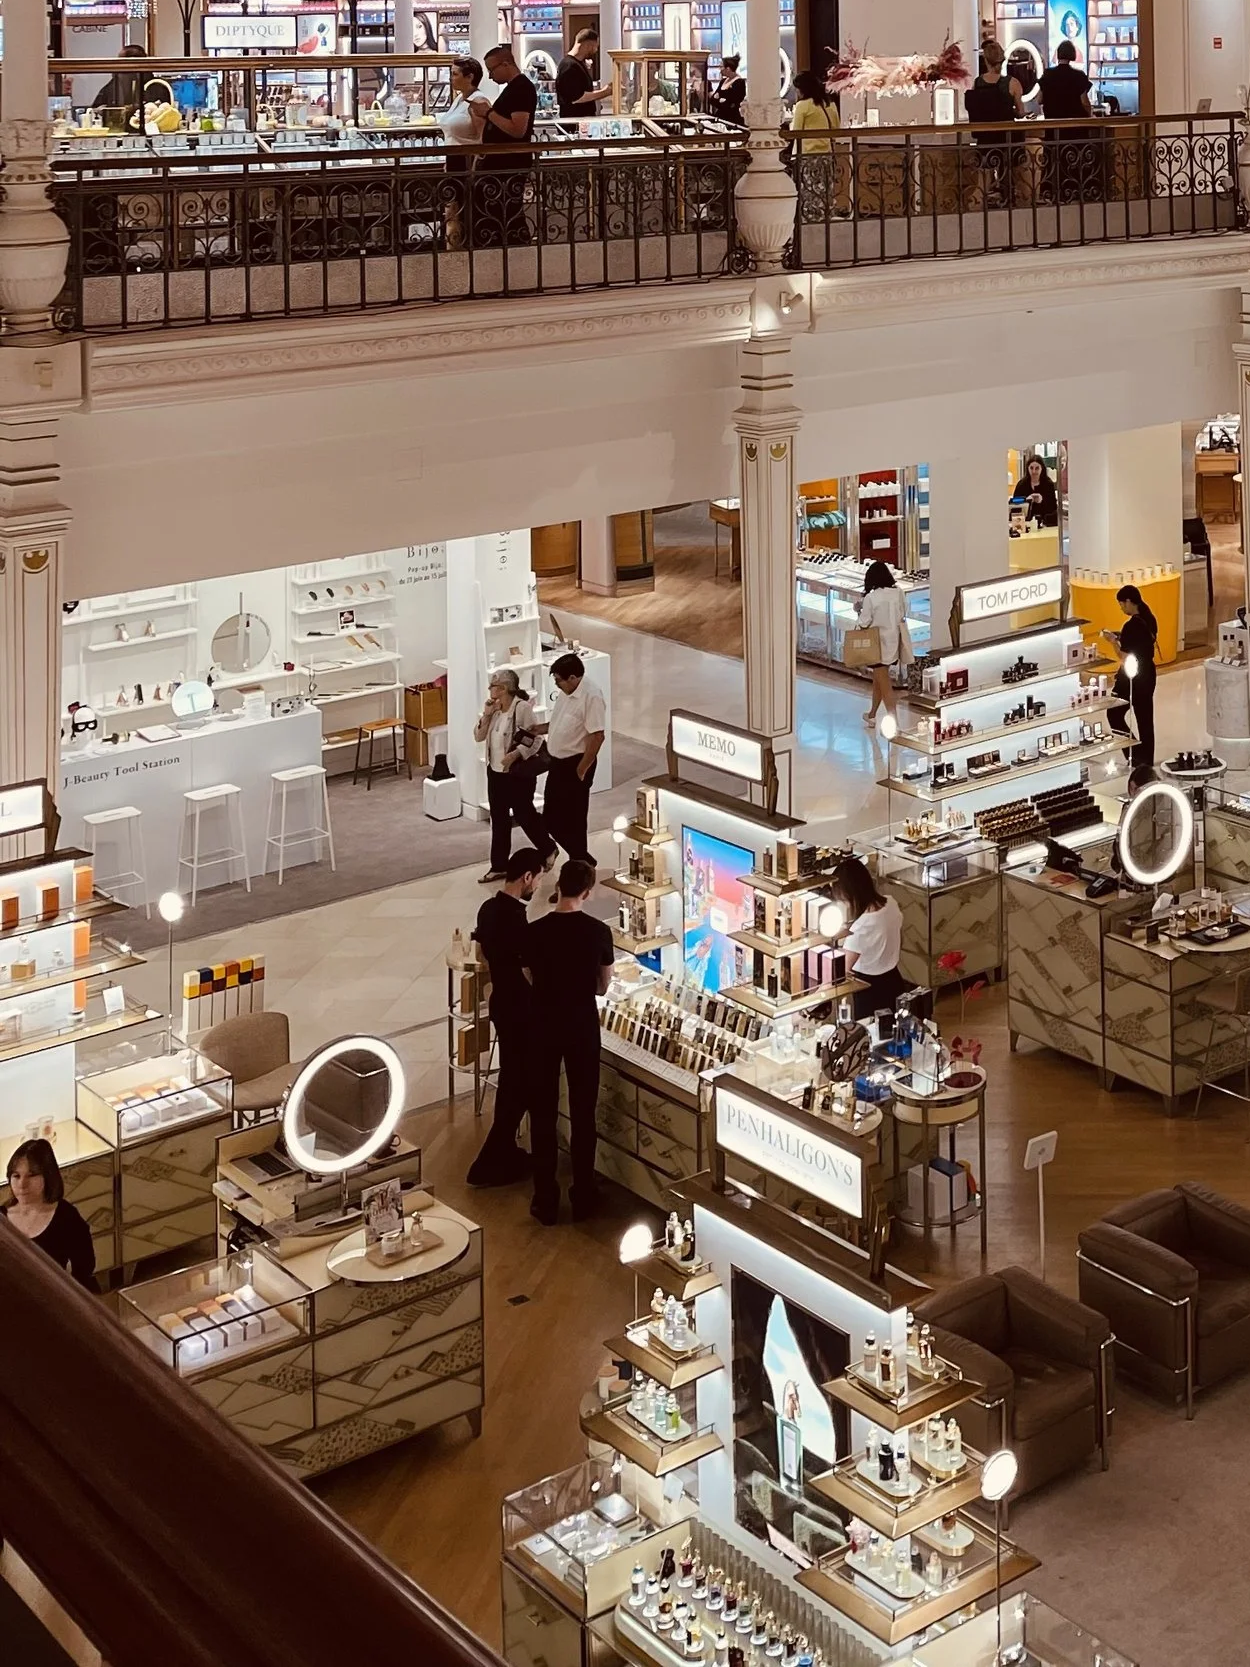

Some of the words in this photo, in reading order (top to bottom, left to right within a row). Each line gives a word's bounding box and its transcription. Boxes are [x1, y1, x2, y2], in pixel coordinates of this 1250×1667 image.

[216, 25, 285, 38] DIPTYQUE
[977, 591, 1008, 610] TOM
[1010, 583, 1048, 603] FORD
[697, 731, 736, 757] MEMO
[63, 771, 109, 789] J-Beauty
[113, 762, 139, 776] Tool
[142, 756, 180, 769] Station
[726, 1104, 853, 1186] PENHALIGON'S
